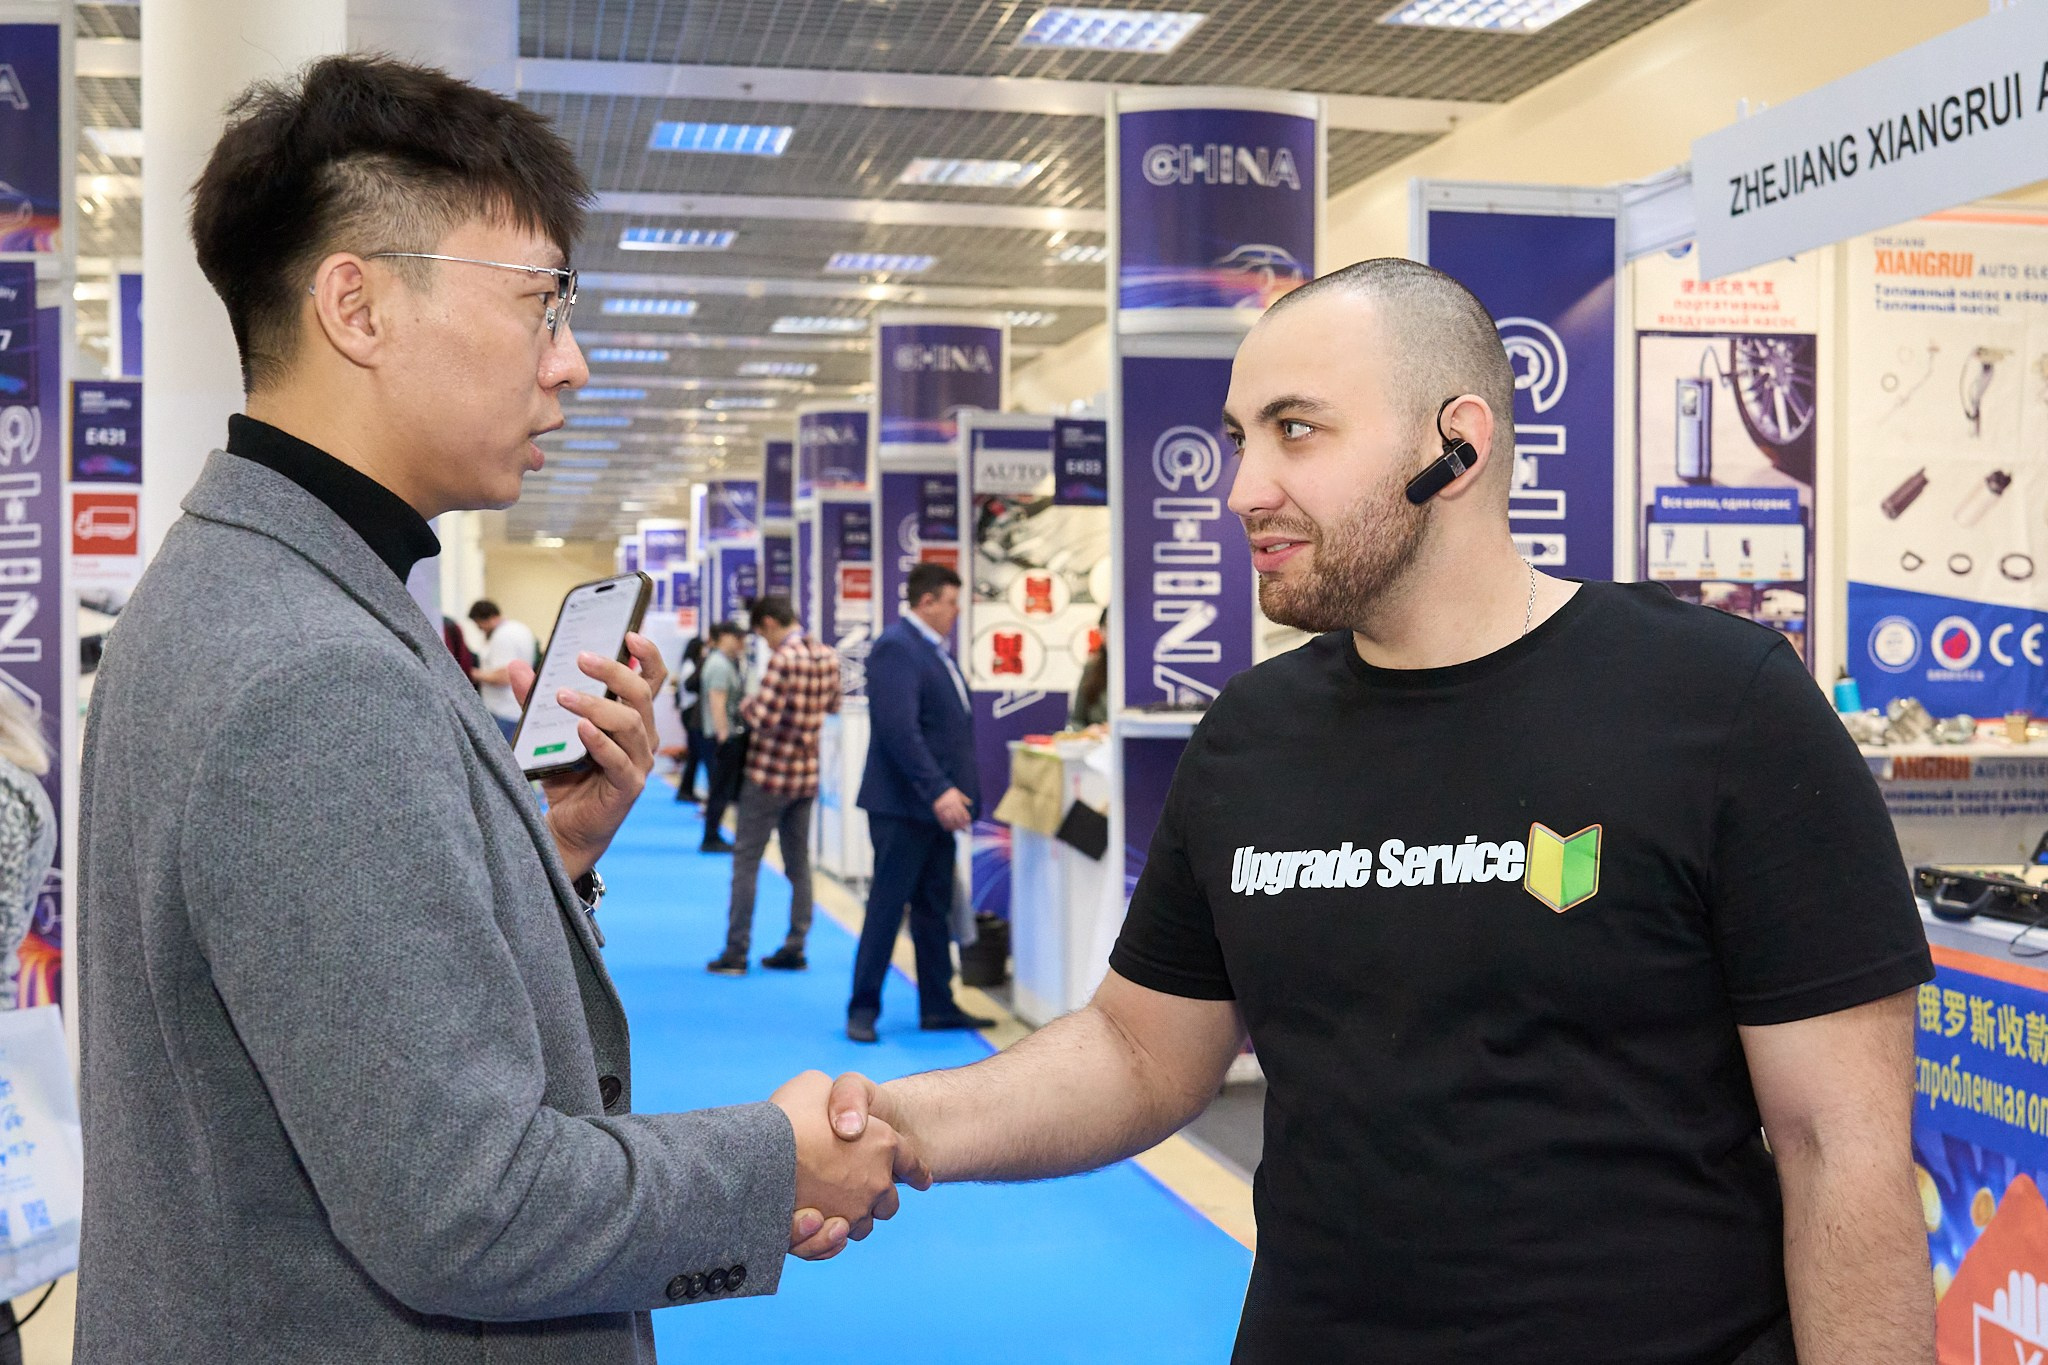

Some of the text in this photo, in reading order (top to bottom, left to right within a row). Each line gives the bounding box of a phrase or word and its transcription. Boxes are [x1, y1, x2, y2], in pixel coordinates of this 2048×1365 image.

[1730, 135, 1858, 217] ZHEJIANG
[1867, 72, 2022, 170] XIANGRUI
[1142, 143, 1301, 190] CHINA
[1875, 249, 1975, 279] XIANGRUI
[1978, 265, 2018, 278] AUTO
[892, 343, 994, 375] CHINA
[84, 427, 127, 446] E431
[984, 462, 1049, 482] AUTO
[1893, 756, 1971, 781] ANGRUI
[1231, 835, 1526, 896] Upgrade Service
[1917, 983, 2048, 1066] 俄罗斯收款
[1915, 1054, 2026, 1129] проблемная
